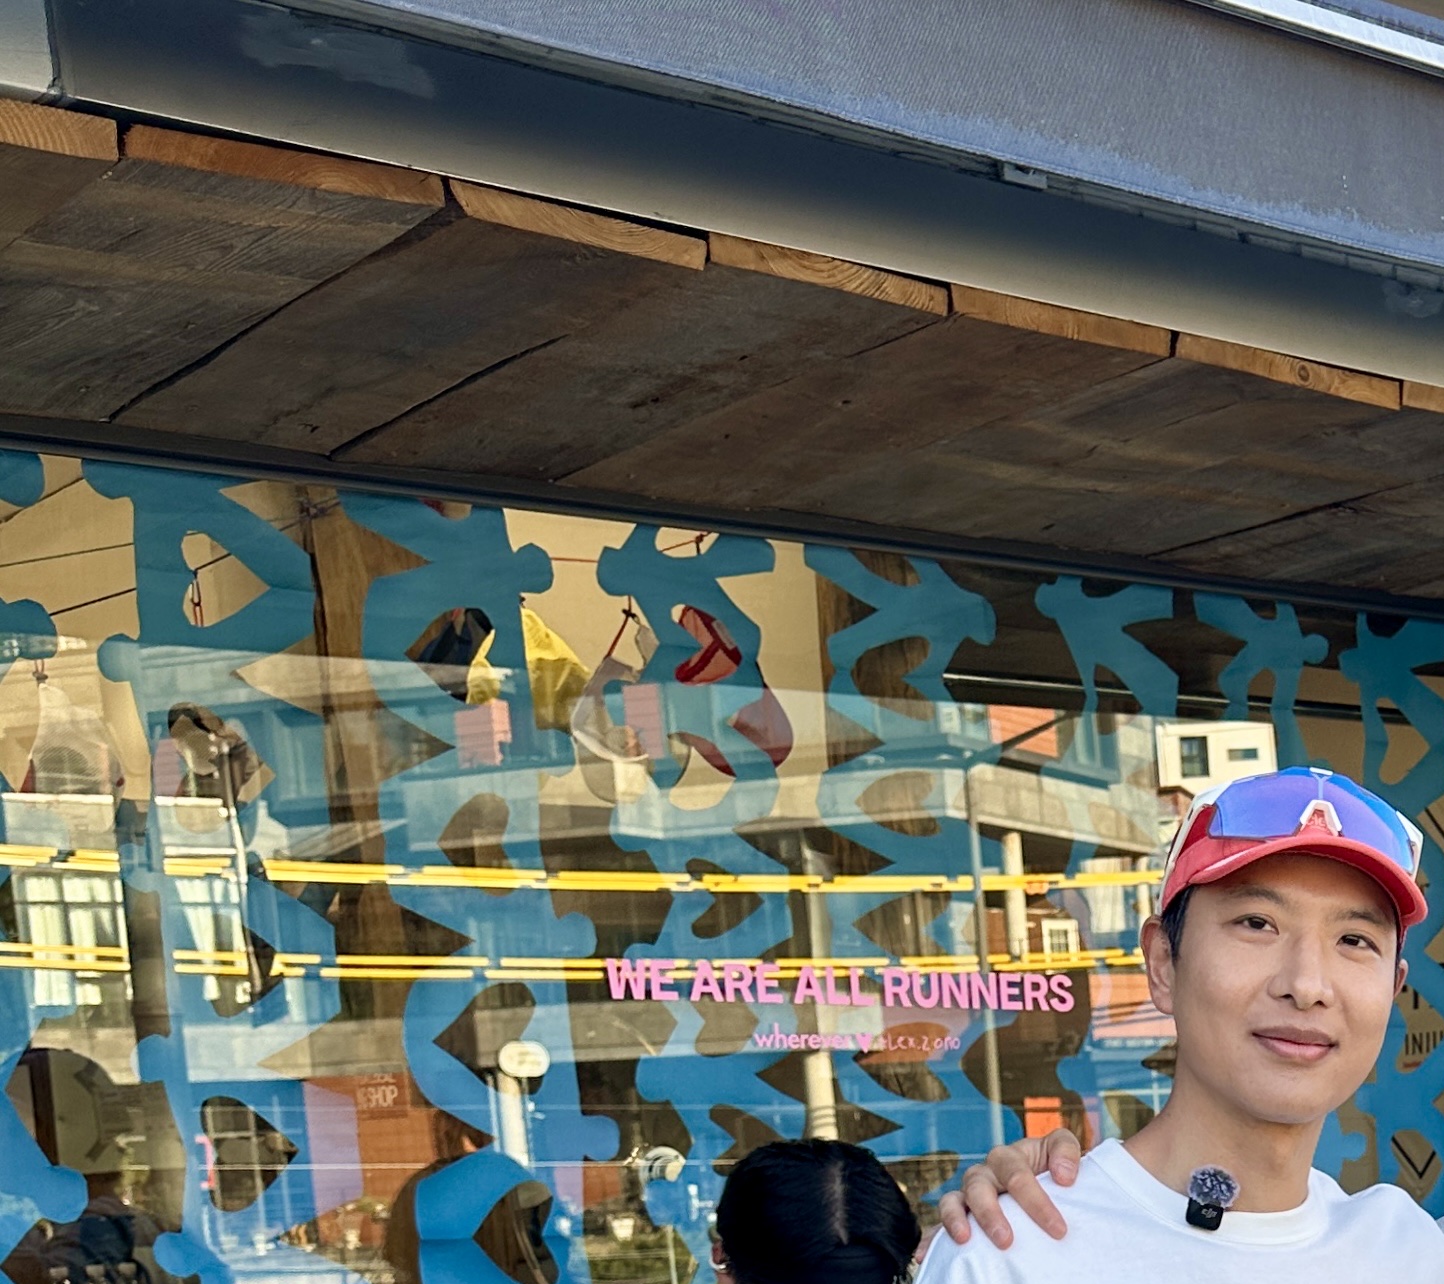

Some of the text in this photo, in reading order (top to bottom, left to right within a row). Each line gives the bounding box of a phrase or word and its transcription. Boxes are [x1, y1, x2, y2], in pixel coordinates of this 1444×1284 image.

[606, 959, 1075, 1013] WE ARE ALL RUNNERS
[754, 1023, 852, 1049] wherever
